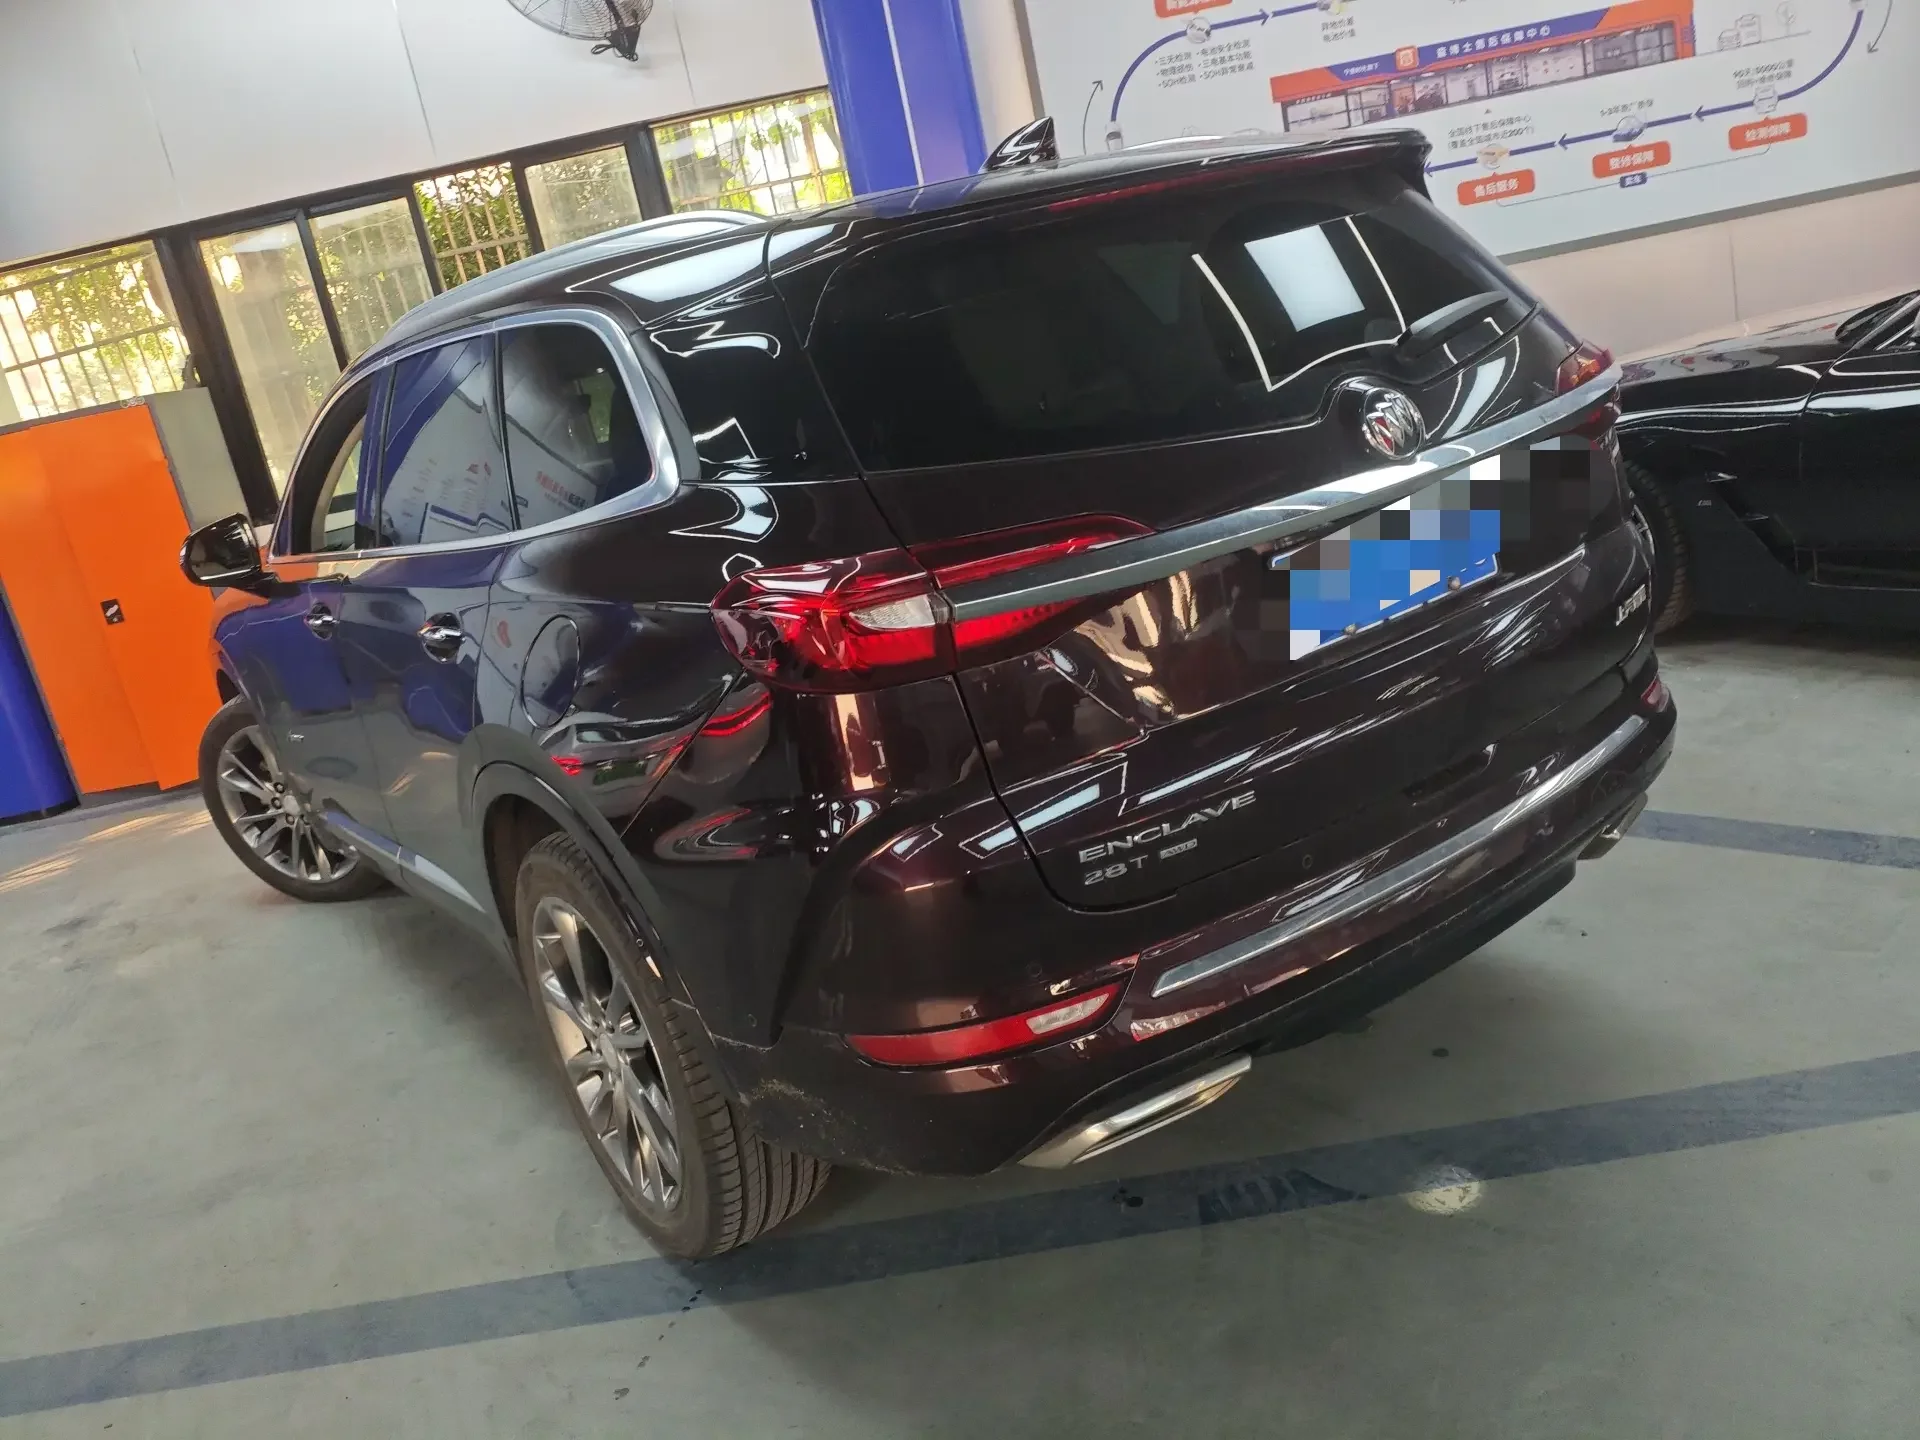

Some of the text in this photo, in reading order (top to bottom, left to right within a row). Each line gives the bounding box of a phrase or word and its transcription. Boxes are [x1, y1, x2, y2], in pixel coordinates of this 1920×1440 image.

[1473, 178, 1520, 198] 售后服务
[1079, 790, 1256, 863] ENCLAVE
[1160, 838, 1198, 860] AWD
